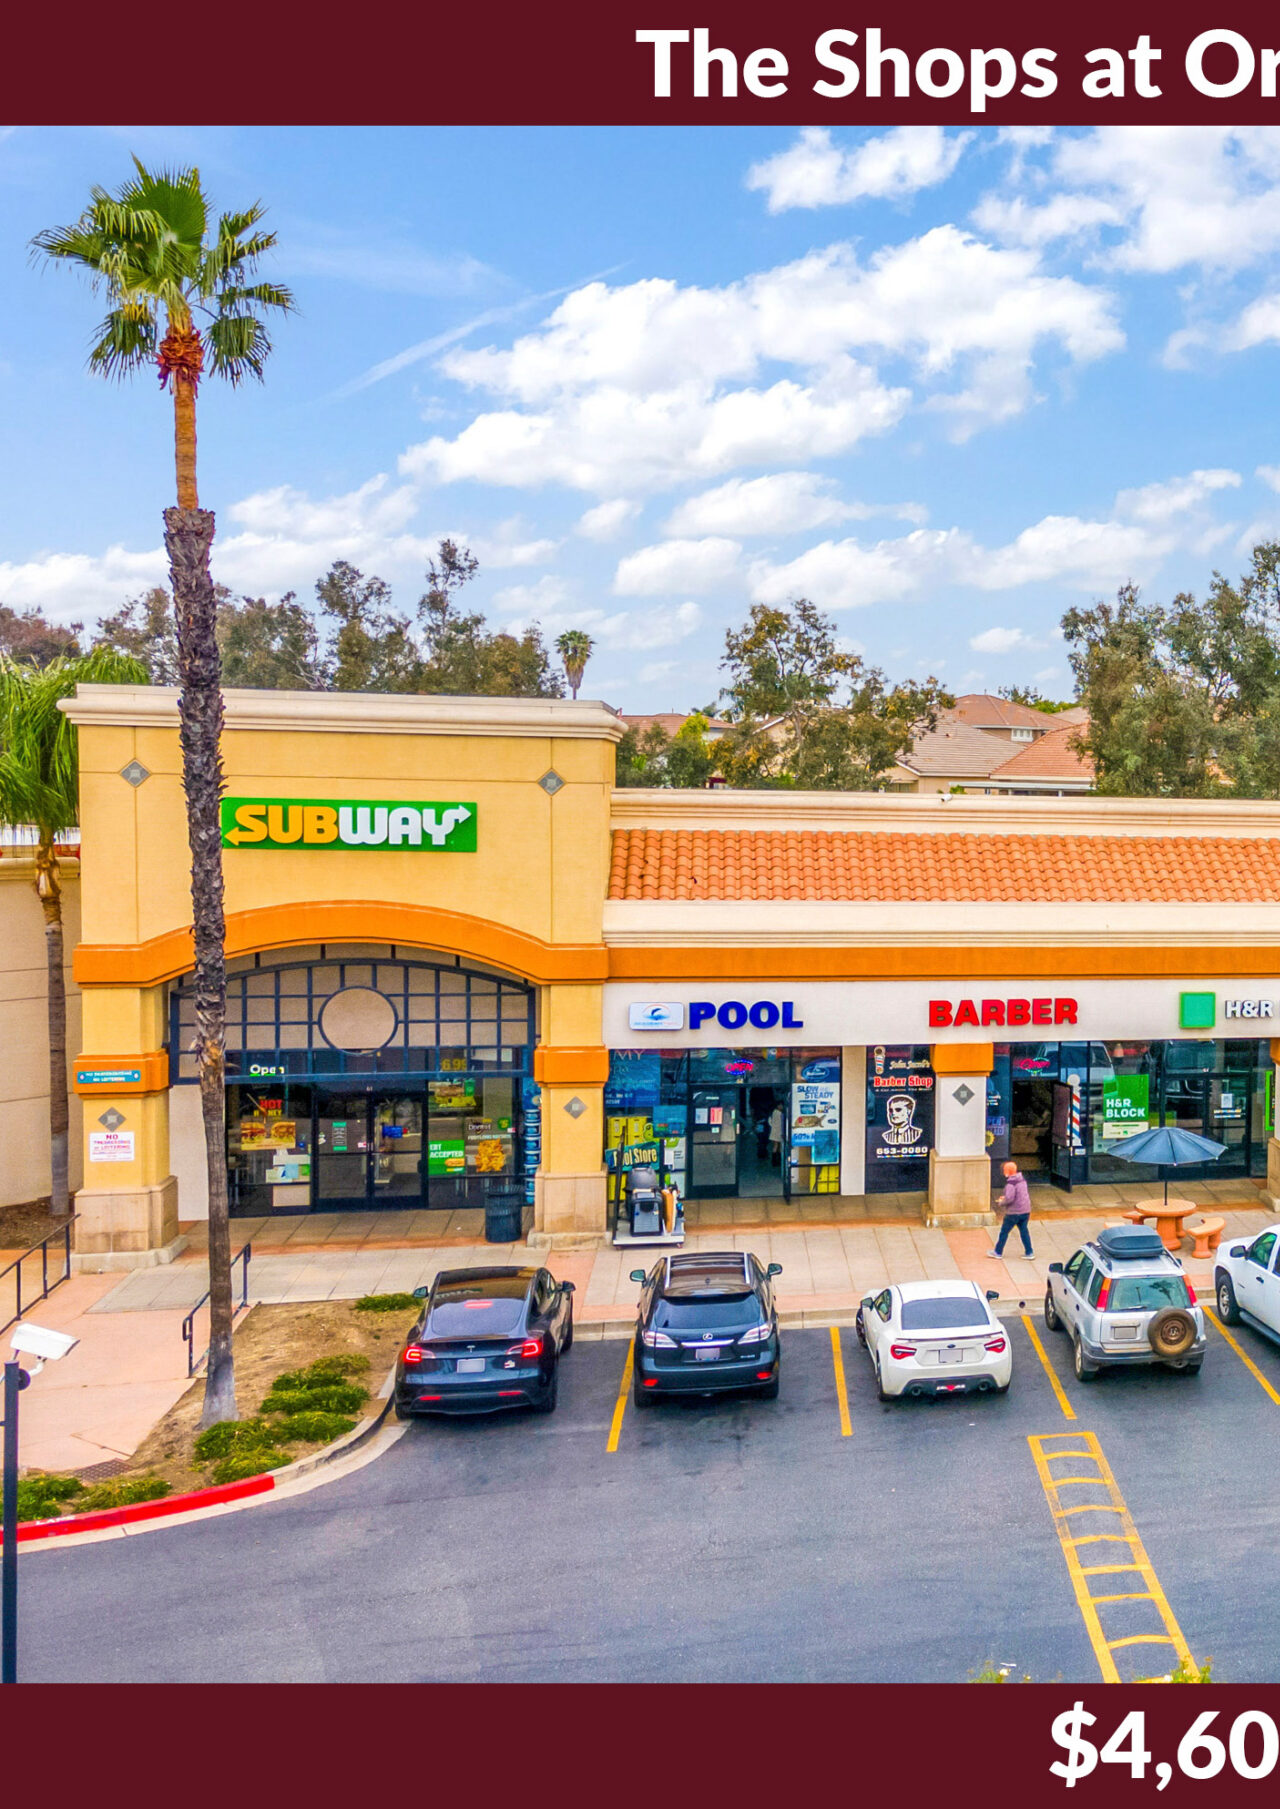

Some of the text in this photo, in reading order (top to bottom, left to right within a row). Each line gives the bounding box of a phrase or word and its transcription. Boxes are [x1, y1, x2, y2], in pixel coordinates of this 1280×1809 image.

[224, 805, 472, 846] SUBWAY
[689, 1001, 803, 1029] POOL
[929, 998, 1078, 1027] BARBER
[1225, 1000, 1273, 1018] H&R
[874, 1074, 933, 1088] Barber Shop
[260, 1099, 282, 1109] HOT
[1106, 1098, 1131, 1108] H&R
[253, 1109, 282, 1117] HNEY
[1106, 1107, 1146, 1118] BLOCK
[429, 1143, 442, 1151] EBT
[634, 1147, 657, 1163] Store
